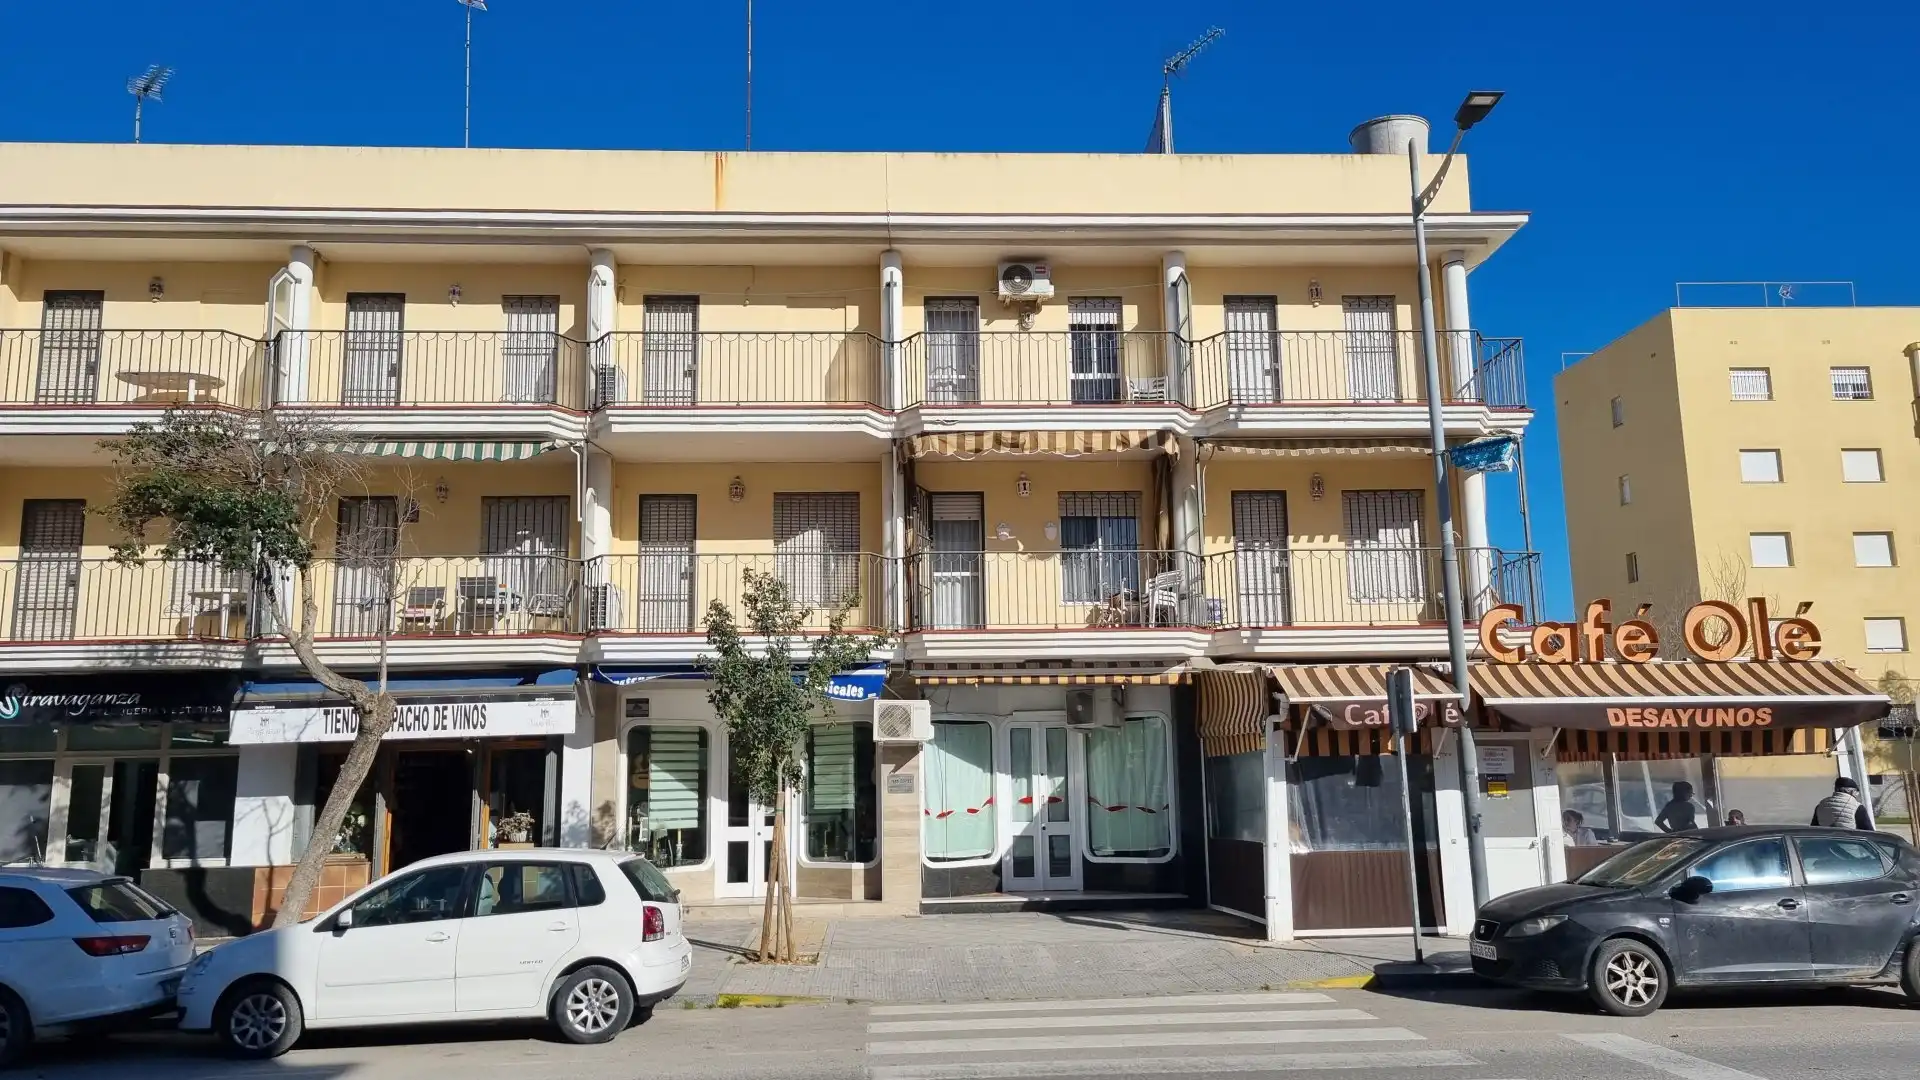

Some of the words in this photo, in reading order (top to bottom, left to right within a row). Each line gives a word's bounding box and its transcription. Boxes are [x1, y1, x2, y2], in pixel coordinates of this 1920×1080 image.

[1479, 597, 1661, 664] Café
[1683, 596, 1822, 662] Olé
[323, 708, 359, 734] TIEND
[433, 705, 448, 731] DE
[452, 703, 487, 730] VINOS
[1344, 703, 1390, 726] Caf
[1606, 707, 1773, 728] DESAYUNOS
